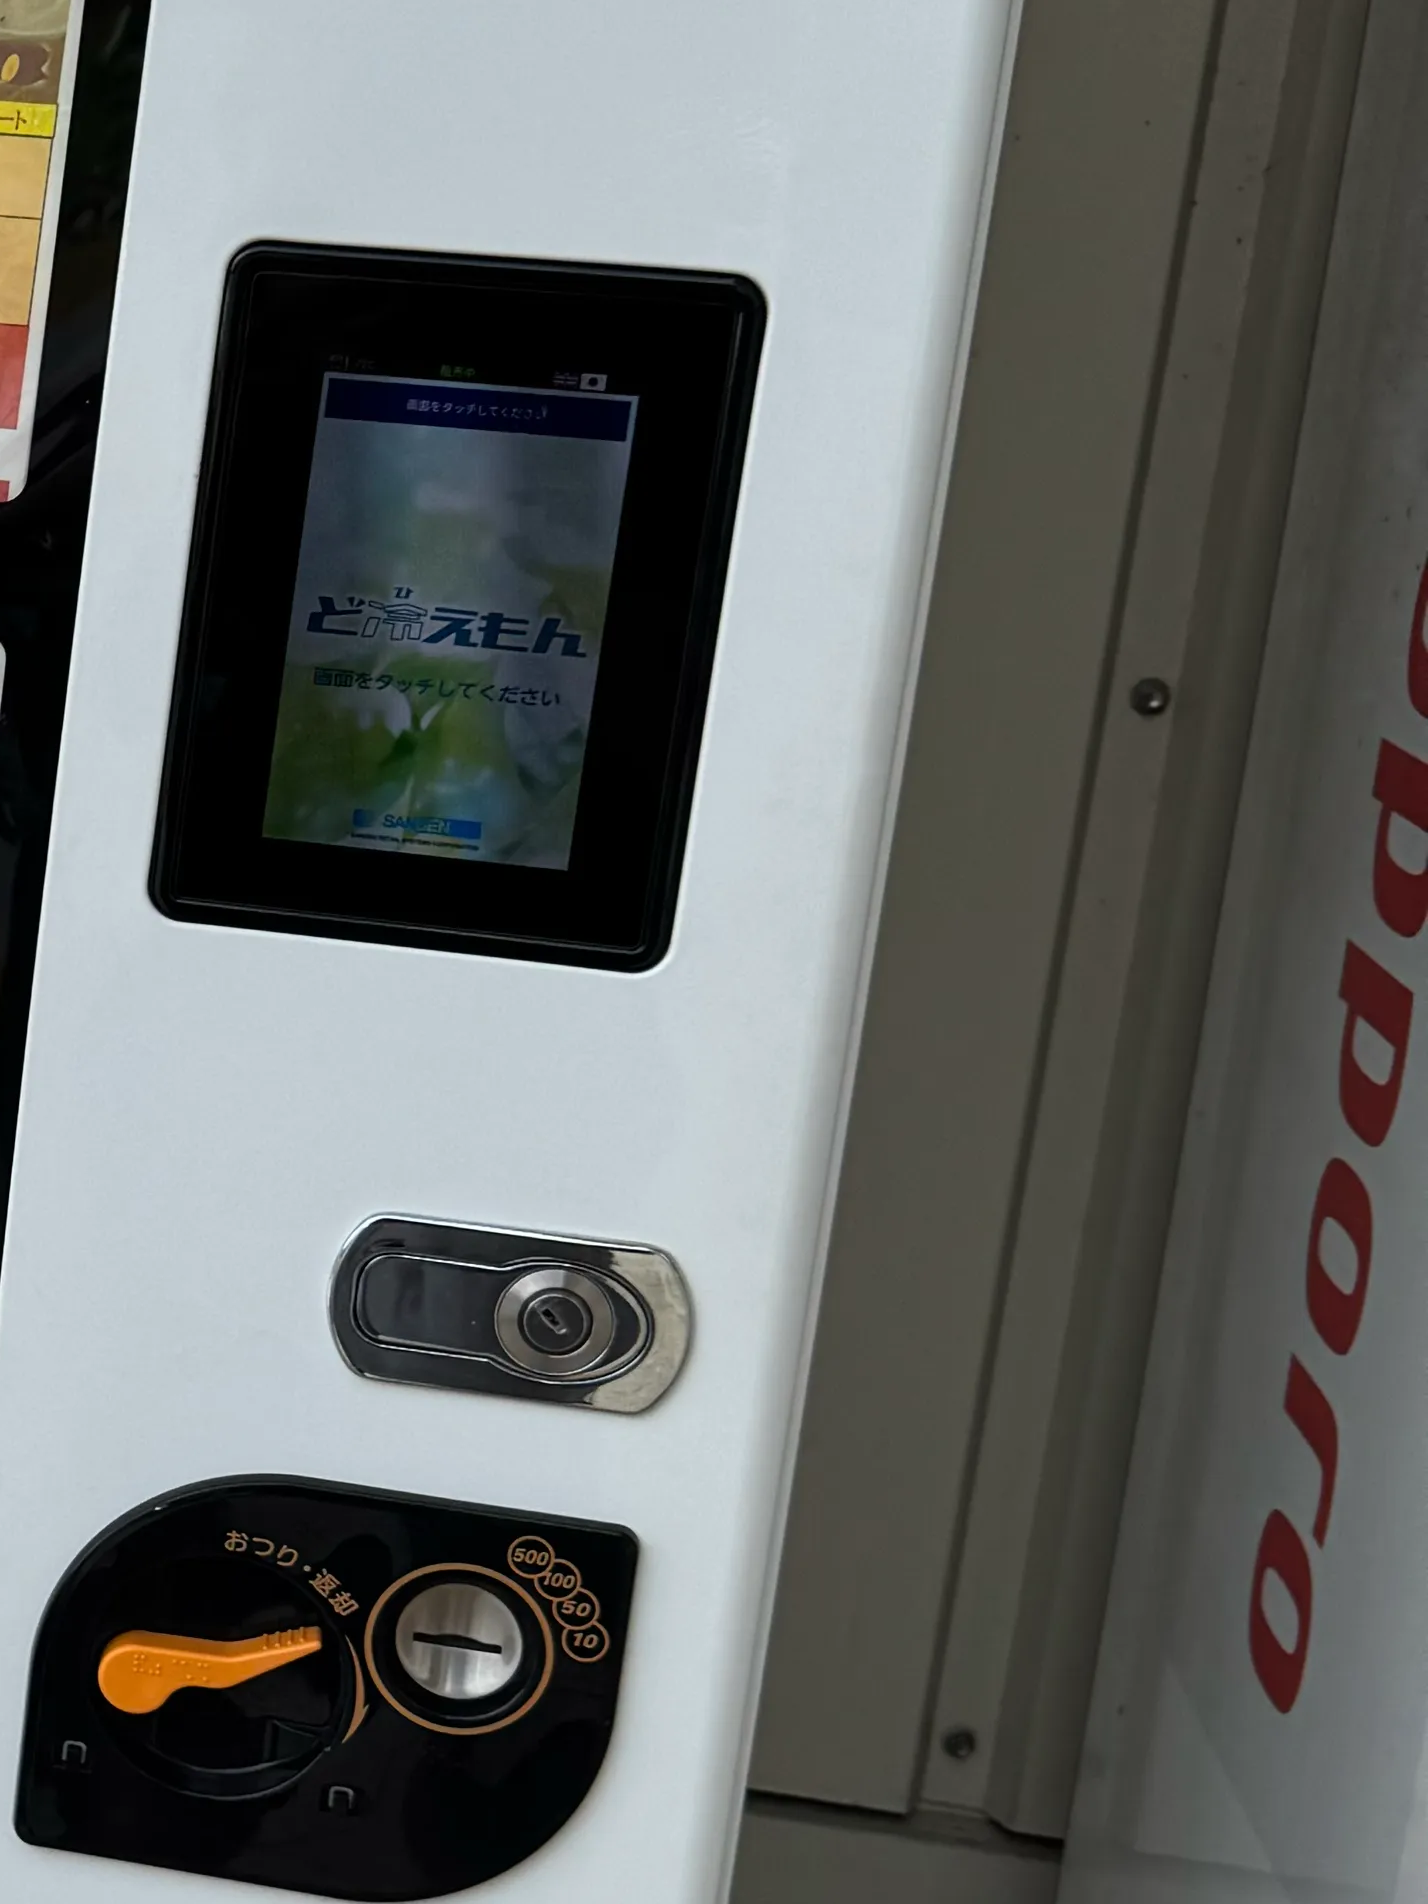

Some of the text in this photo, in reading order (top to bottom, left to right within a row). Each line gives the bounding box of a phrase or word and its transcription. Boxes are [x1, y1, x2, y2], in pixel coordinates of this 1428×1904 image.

[306, 595, 588, 659] ど冷えもん
[313, 666, 561, 708] 画面をタッチしてください
[1249, 548, 1428, 1715] pporo
[223, 1529, 360, 1617] おつり・返却
[510, 1548, 550, 1567] 500
[561, 1600, 590, 1617] 50
[572, 1633, 598, 1649] 10
